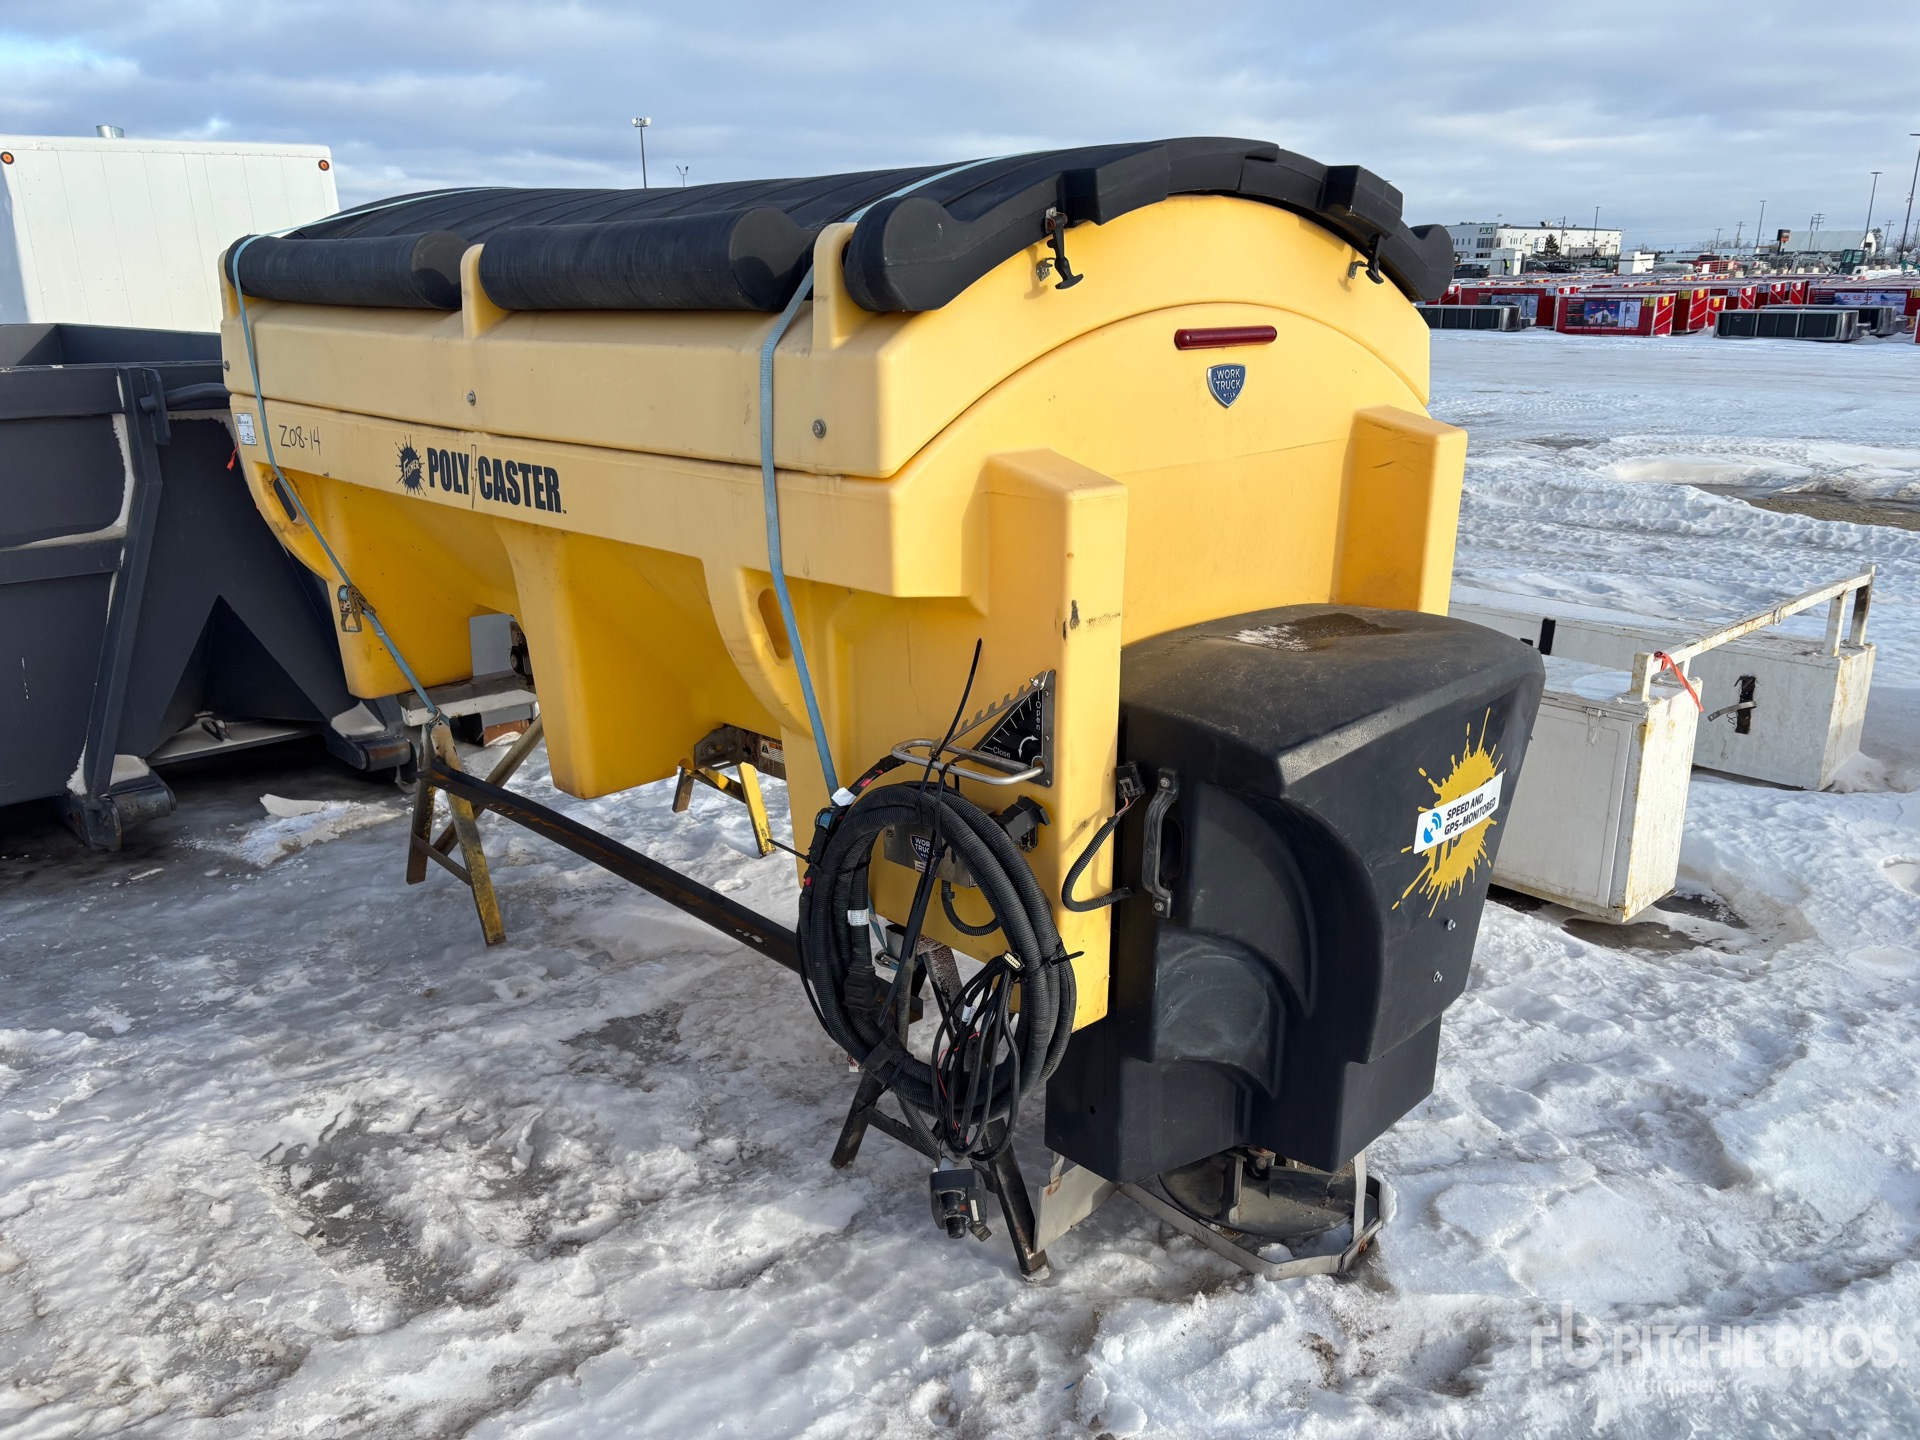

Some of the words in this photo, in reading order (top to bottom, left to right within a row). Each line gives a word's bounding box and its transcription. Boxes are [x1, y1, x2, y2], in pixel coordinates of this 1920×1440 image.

[1216, 368, 1240, 380] WORK
[1216, 379, 1241, 390] TRUCK
[426, 447, 471, 496] POLY
[477, 456, 563, 514] CASTER
[992, 747, 1010, 758] Close
[1446, 799, 1471, 821] SPEED
[1470, 792, 1484, 811] AND
[1444, 796, 1497, 836] GPS-MONITORED
[914, 837, 931, 848] WOR
